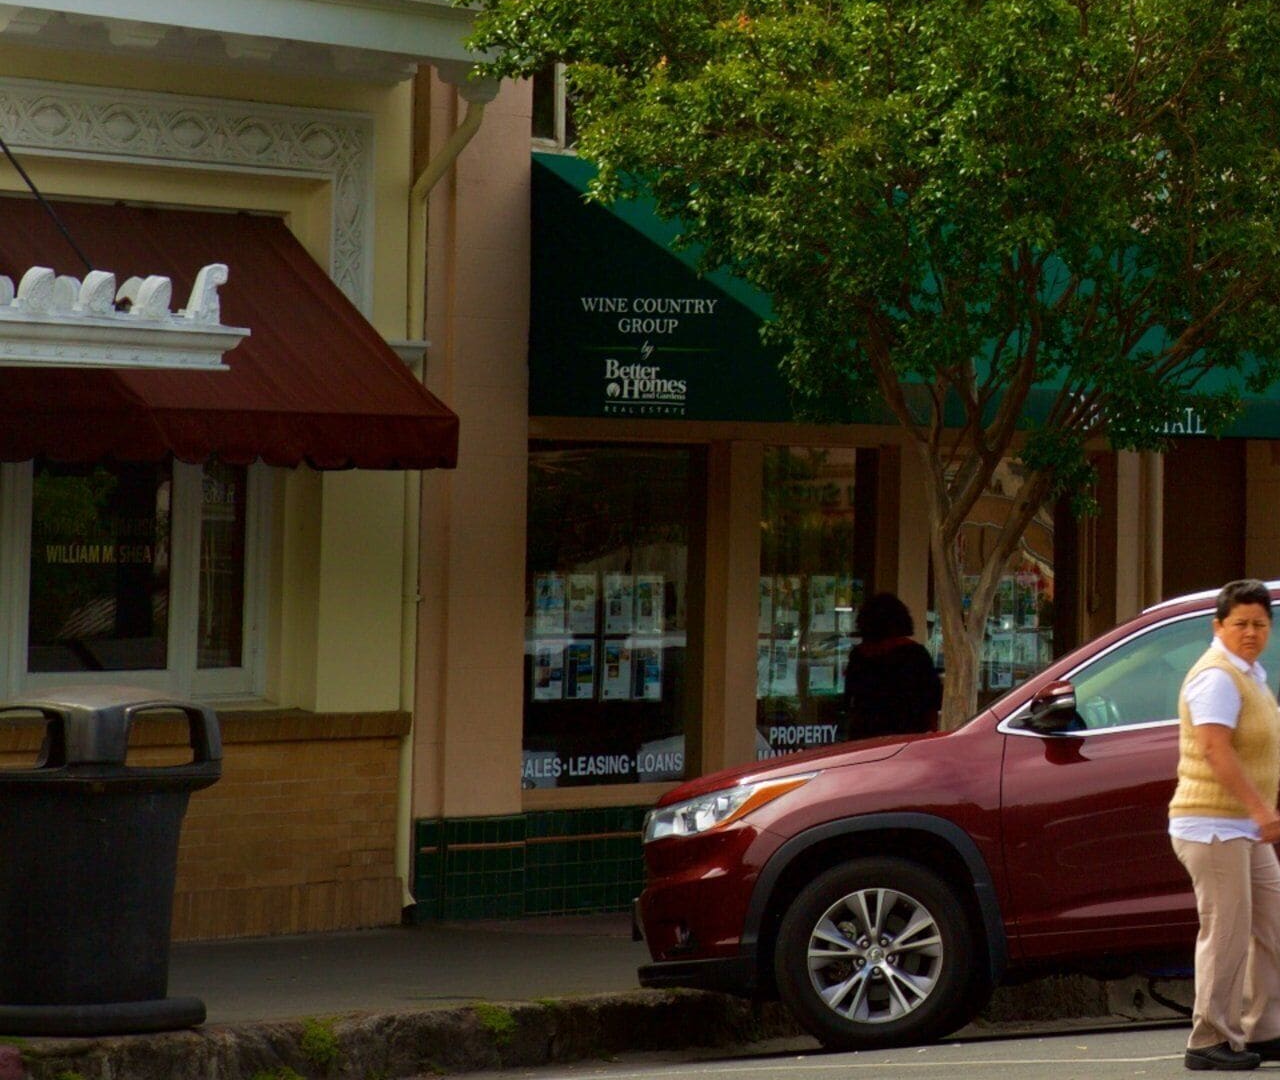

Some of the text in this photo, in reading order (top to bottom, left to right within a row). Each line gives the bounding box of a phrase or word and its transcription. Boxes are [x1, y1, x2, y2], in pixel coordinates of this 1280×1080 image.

[580, 297, 718, 314] WINE COUNTRY
[618, 317, 679, 334] GROUP
[640, 339, 656, 360] by
[604, 358, 660, 379] Better
[621, 378, 688, 399] Homes
[604, 405, 686, 416] REAL ESTATE
[46, 544, 99, 564] WILLIAM
[119, 544, 153, 564] SHEA
[769, 724, 838, 745] PROPERTY
[521, 752, 684, 778] ALES LEASING LOANS
